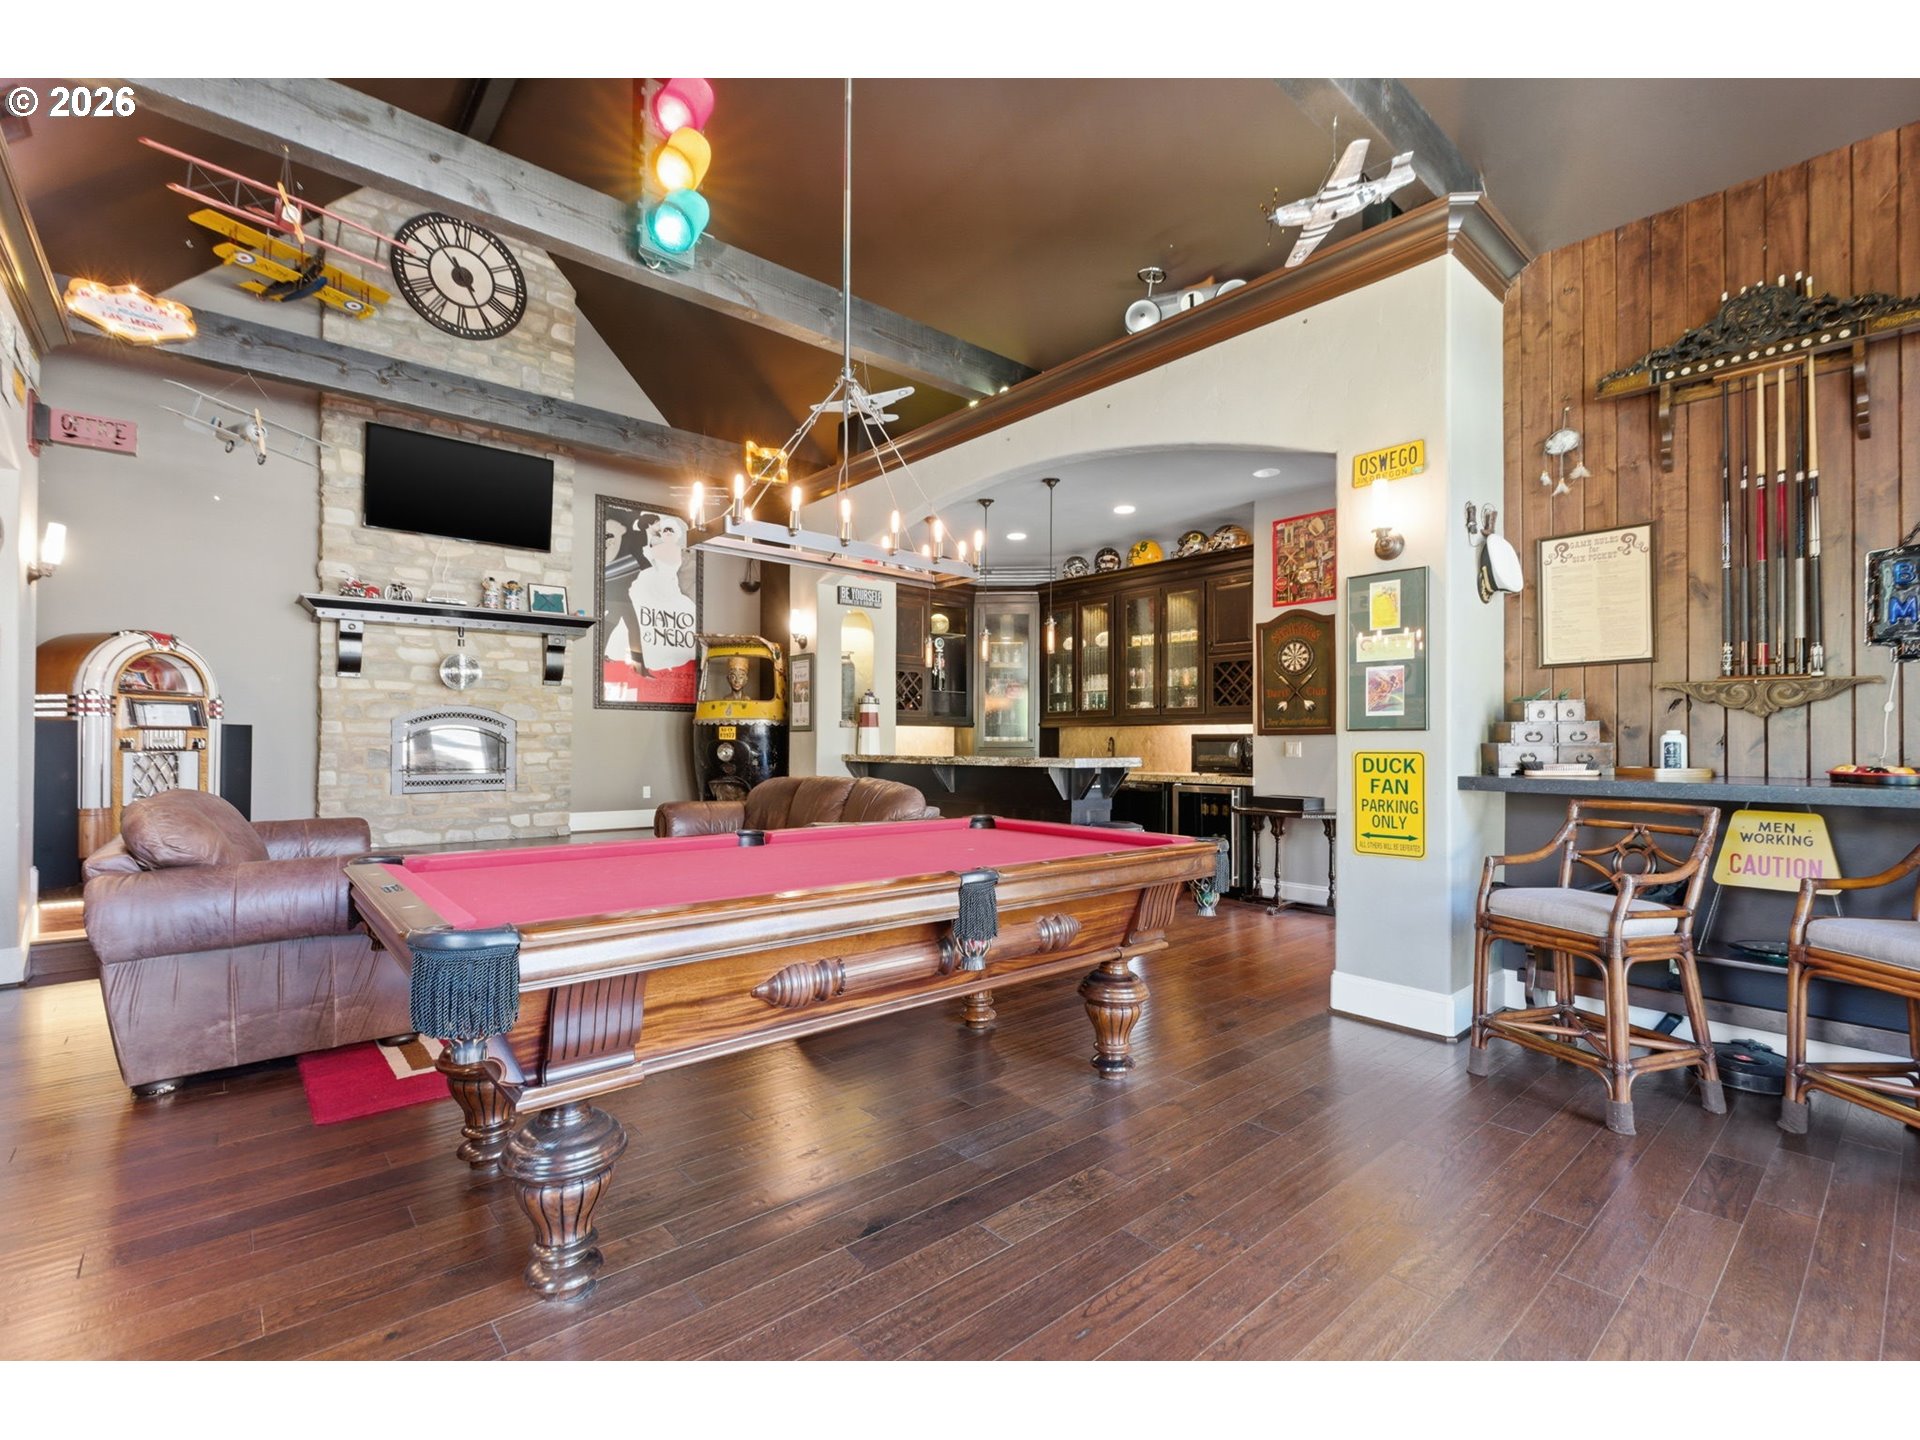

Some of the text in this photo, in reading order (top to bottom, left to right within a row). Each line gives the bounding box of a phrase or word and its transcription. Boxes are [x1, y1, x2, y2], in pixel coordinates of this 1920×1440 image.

[1188, 293, 1195, 308] 1
[1360, 446, 1417, 476] OSWEGO
[841, 586, 881, 603] BE YOURSELF
[653, 628, 695, 649] NERO
[1362, 757, 1416, 774] DUCK
[1370, 778, 1409, 795] FAN
[1361, 798, 1418, 814] PARKING
[1372, 814, 1407, 830] ONLY
[1758, 822, 1795, 834] MEN
[1740, 832, 1814, 847] WORKING
[1729, 853, 1823, 879] CAUTION
